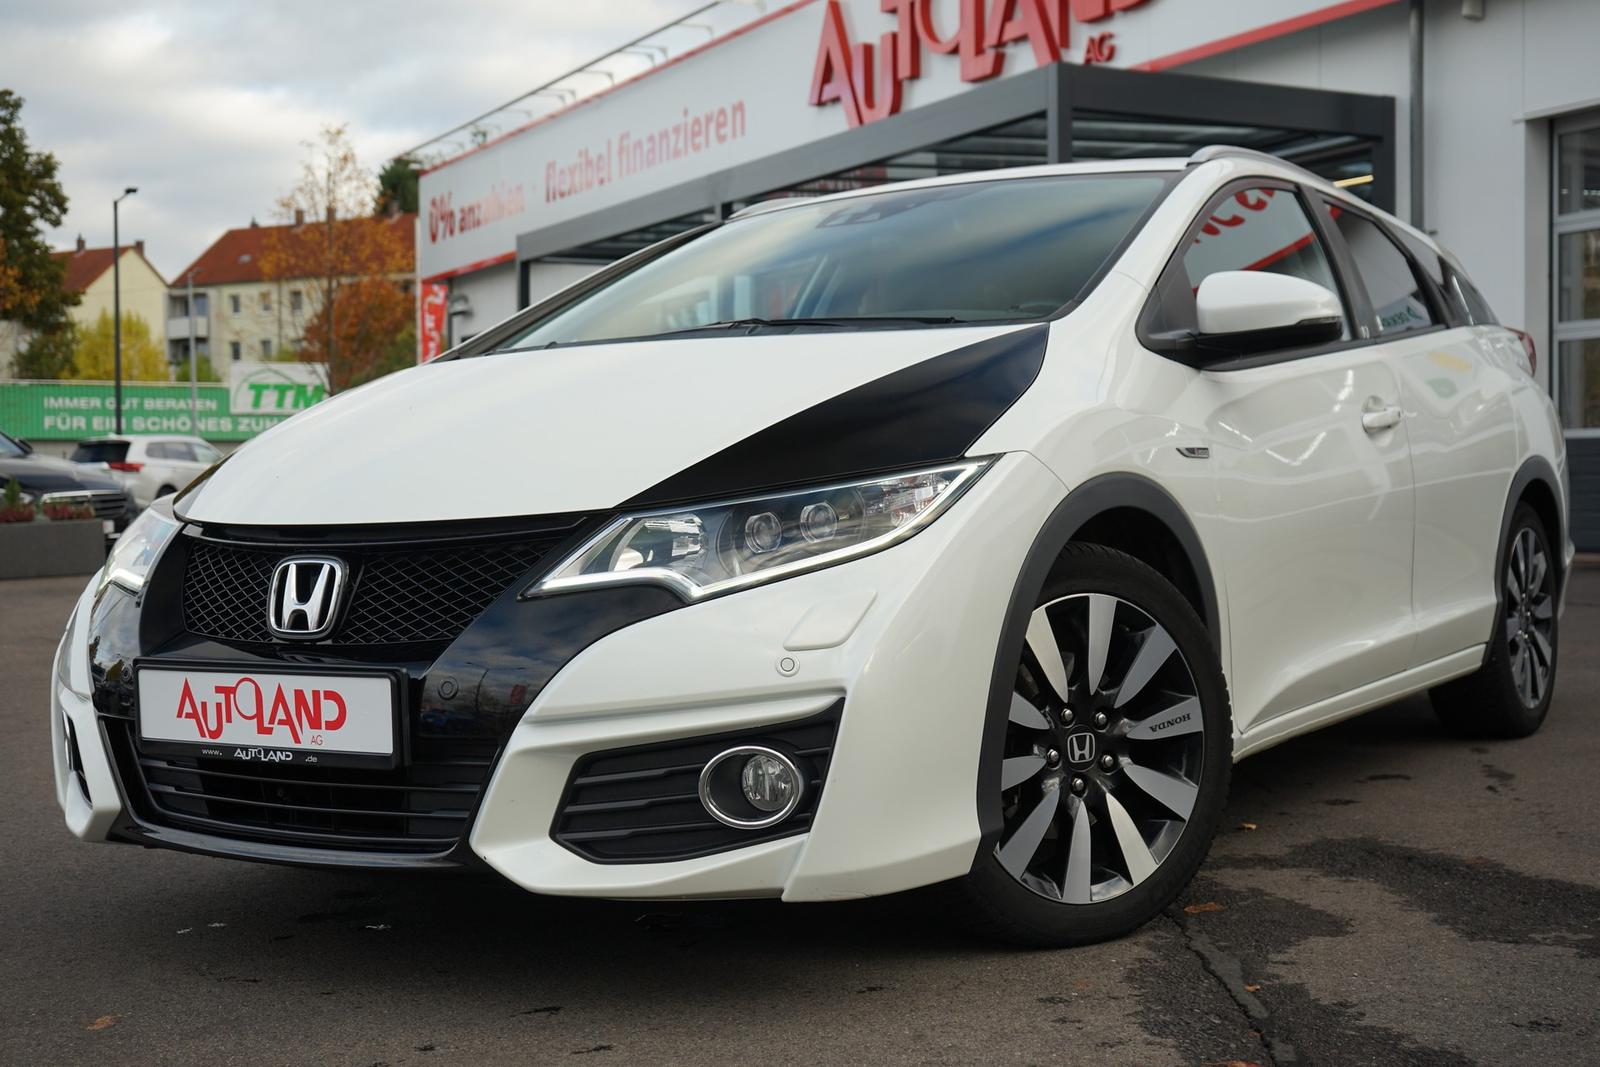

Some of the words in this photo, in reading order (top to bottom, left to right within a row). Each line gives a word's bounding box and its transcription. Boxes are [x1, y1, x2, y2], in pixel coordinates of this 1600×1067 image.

[1084, 31, 1117, 65] AG
[808, 0, 1156, 128] AUTOLA
[544, 138, 613, 204] flexibel
[616, 99, 746, 178] finanzieren
[43, 395, 101, 410] IMMER
[248, 383, 326, 410] TTM
[43, 412, 87, 431] FÜR
[131, 411, 233, 433] SCHÖNES
[176, 676, 348, 745] AUTOLAND
[1149, 713, 1191, 732] HONDA
[310, 734, 323, 746] AG
[233, 747, 294, 763] AUTOLAND
